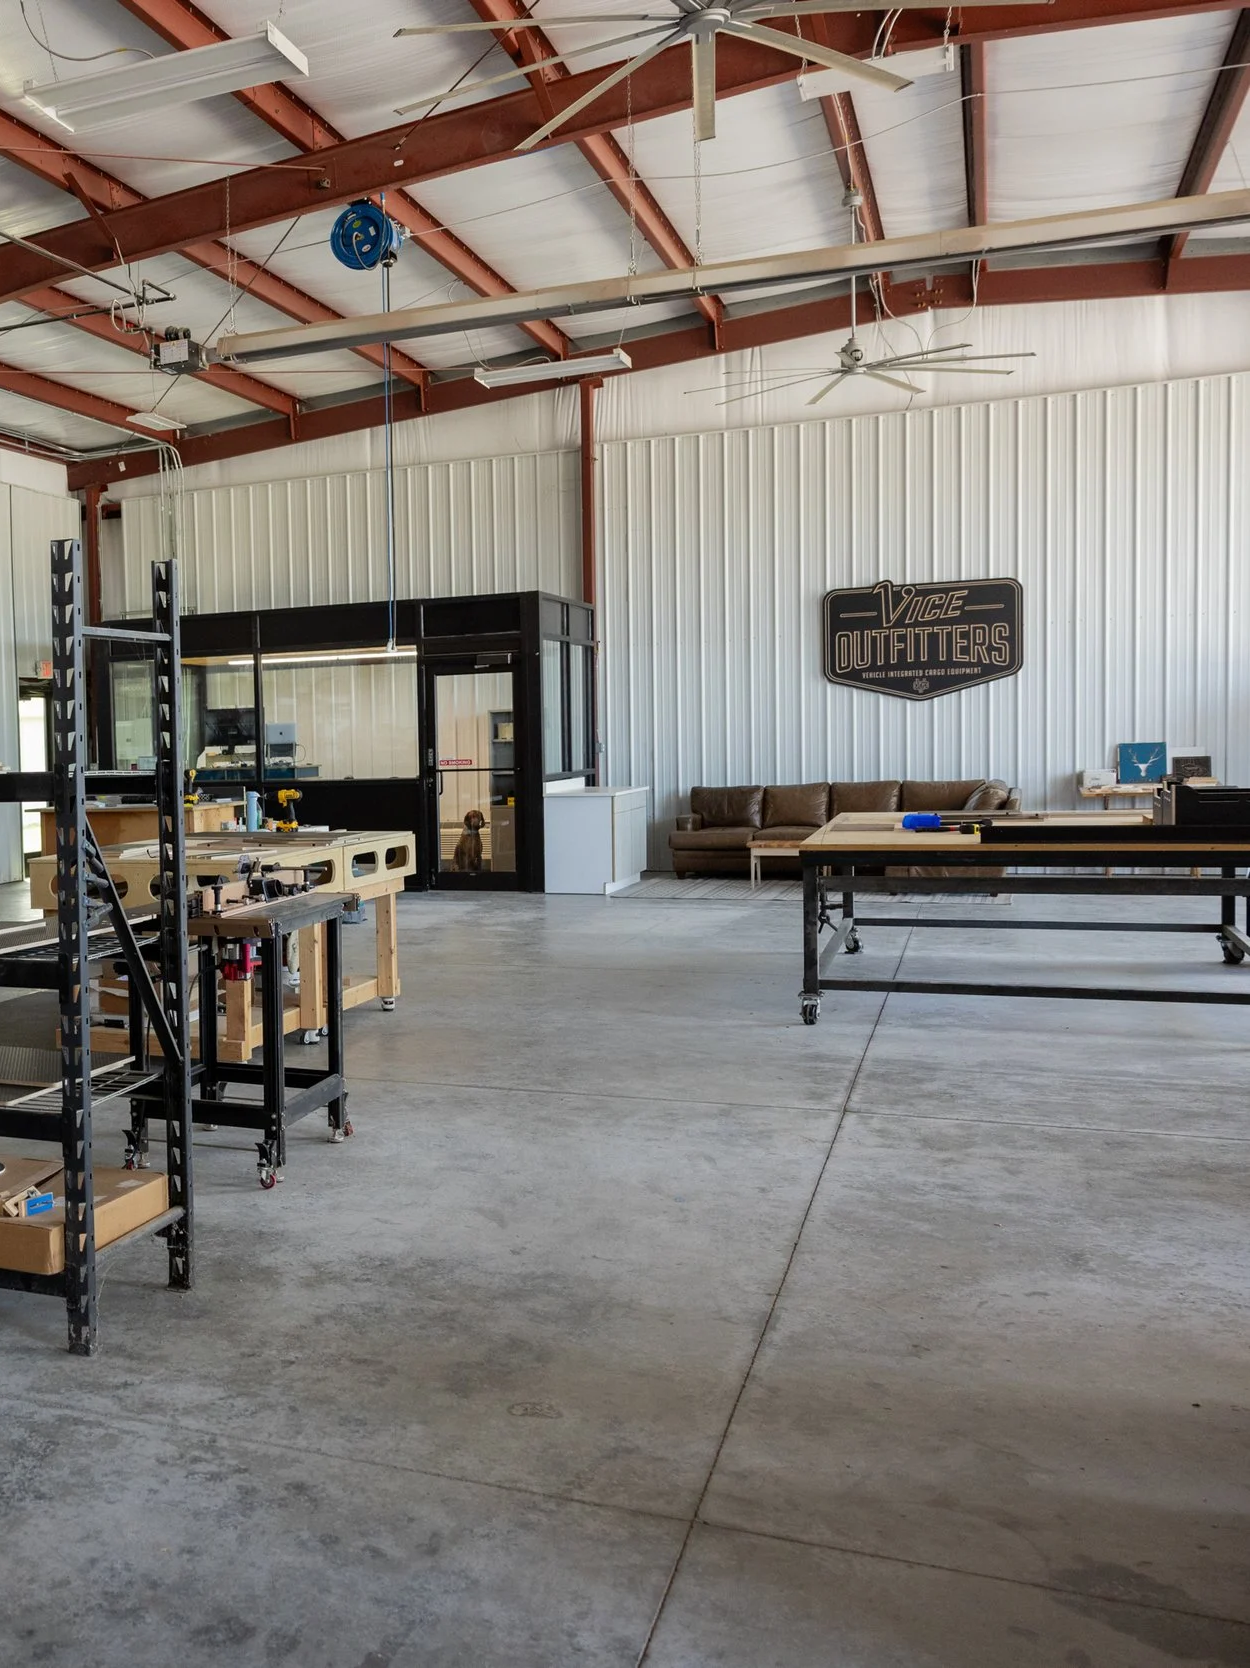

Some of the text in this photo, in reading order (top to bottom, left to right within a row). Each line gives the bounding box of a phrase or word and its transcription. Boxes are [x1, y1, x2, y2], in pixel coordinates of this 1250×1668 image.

[873, 581, 968, 627] VICE
[835, 622, 1009, 673] OUTFITTERS
[862, 667, 982, 679] VEHICLE INTEGRATED CARGO EQUIPMENT
